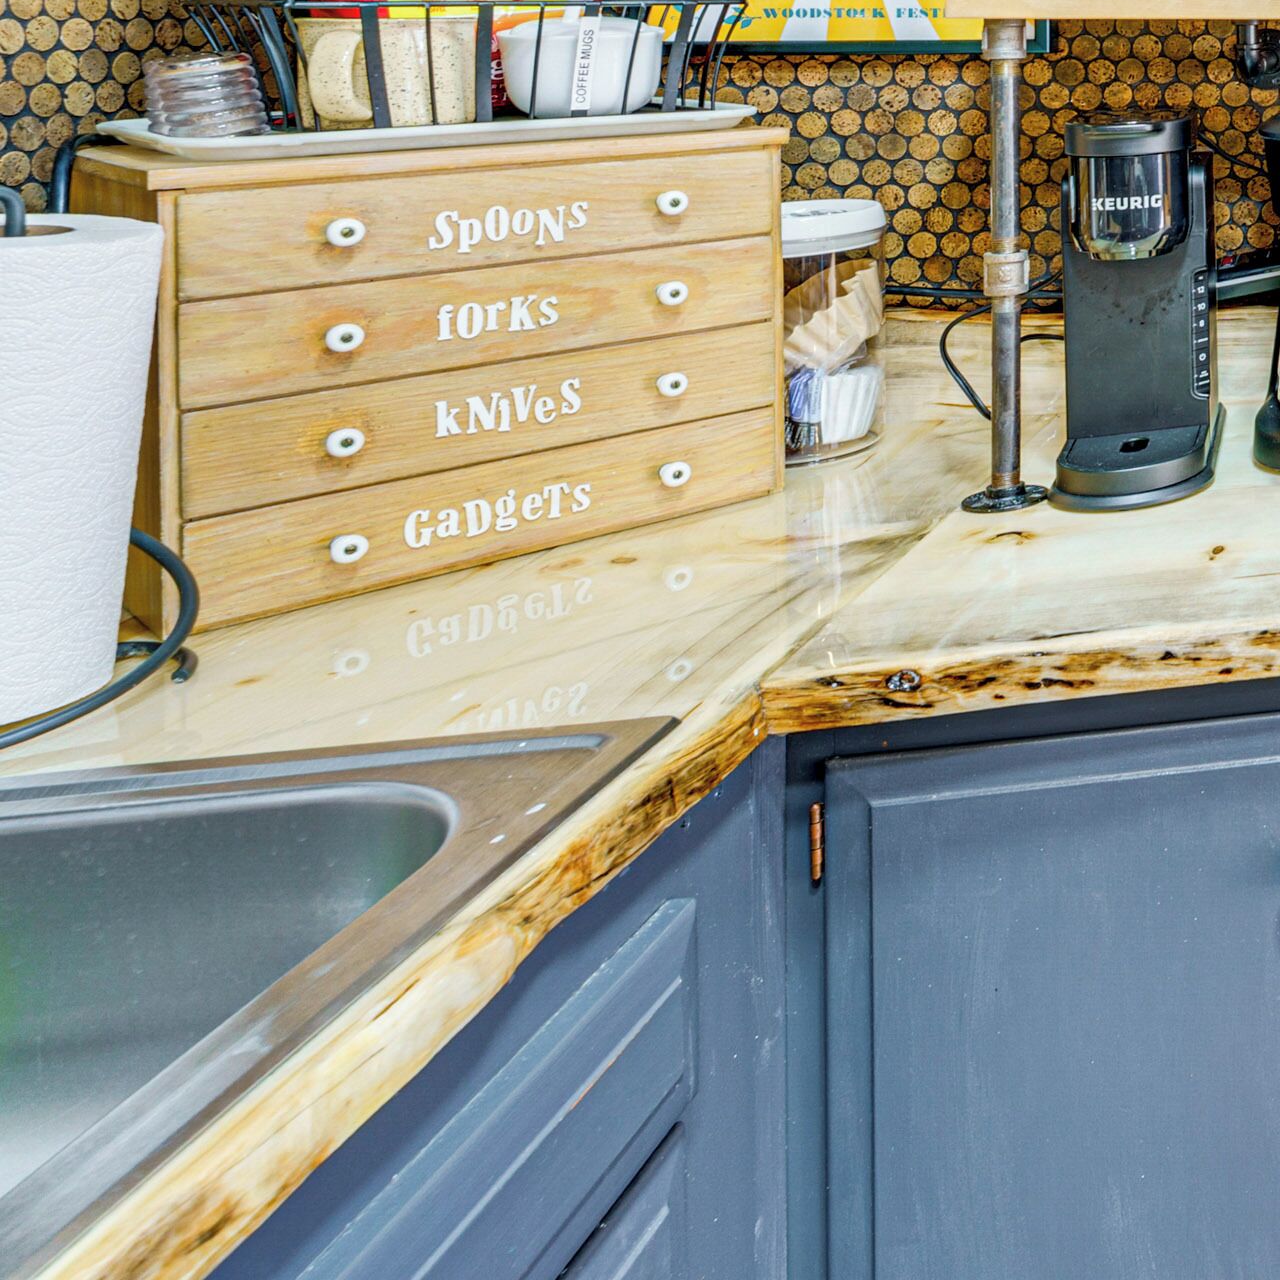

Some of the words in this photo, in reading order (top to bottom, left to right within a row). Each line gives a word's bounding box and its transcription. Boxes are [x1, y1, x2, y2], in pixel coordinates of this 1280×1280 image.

[763, 8, 885, 18] WOODSTOCK
[580, 29, 594, 59] MUGS
[575, 63, 591, 104] COFFEE
[1091, 194, 1163, 211] KEURIG
